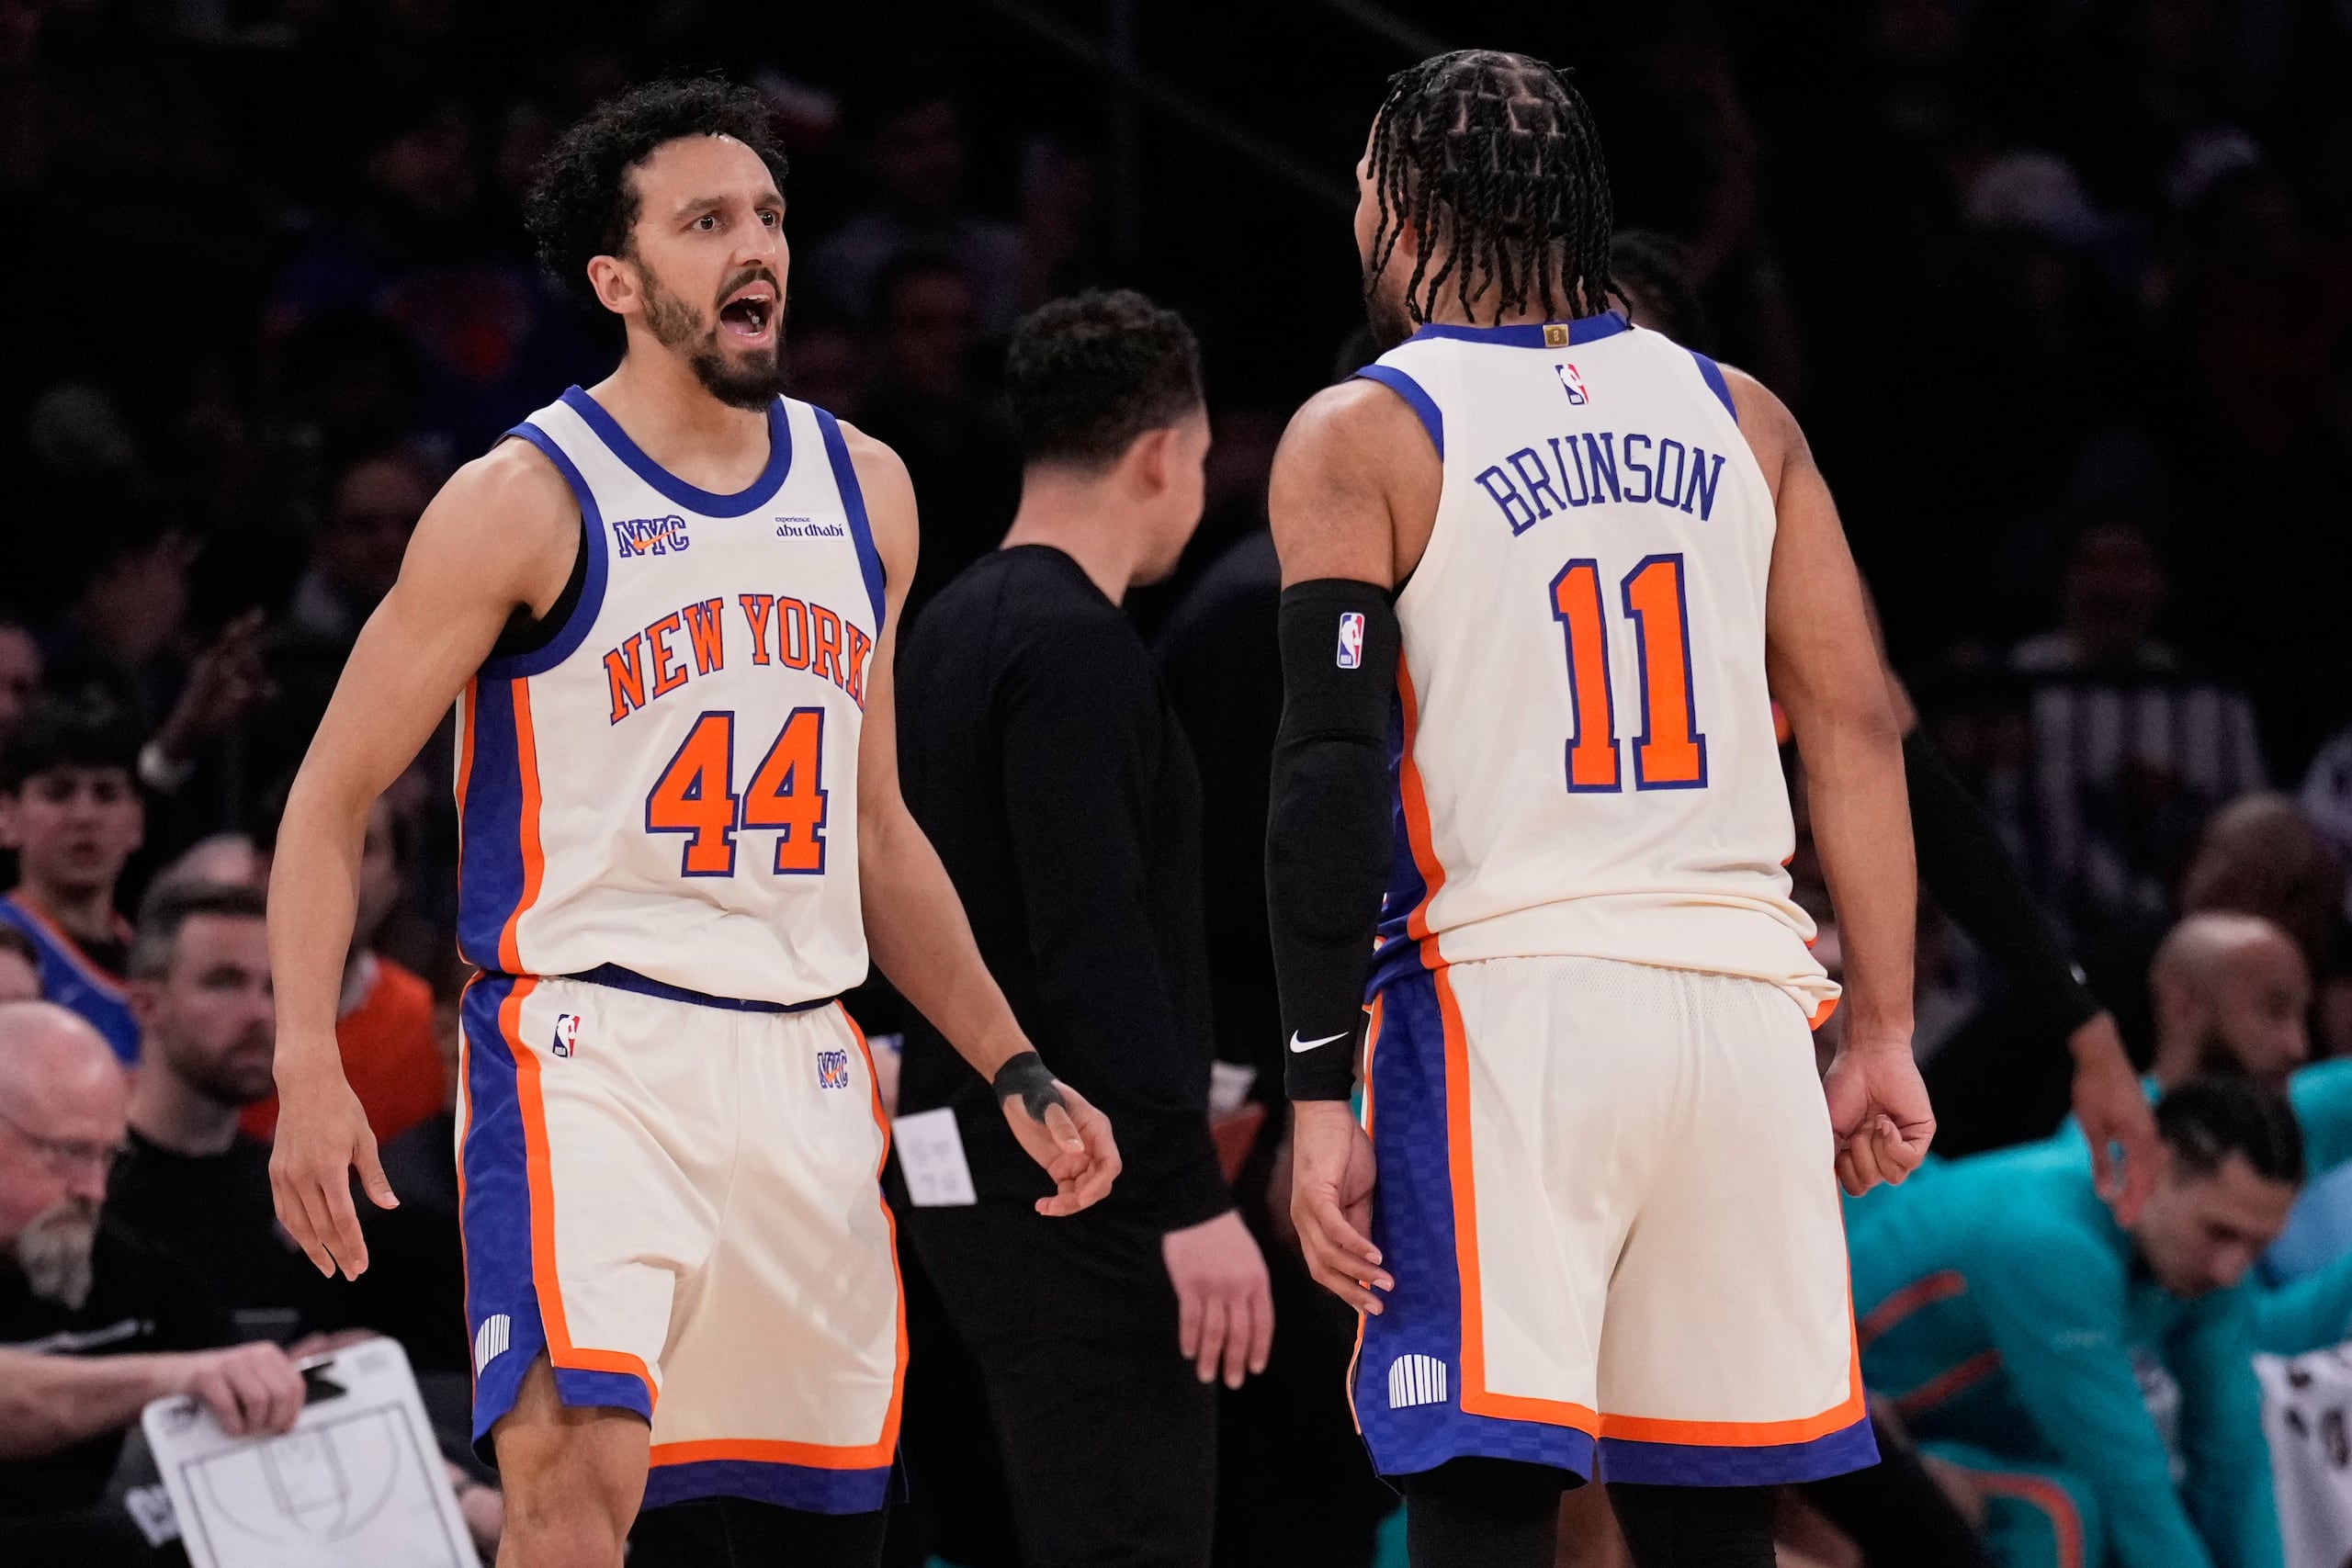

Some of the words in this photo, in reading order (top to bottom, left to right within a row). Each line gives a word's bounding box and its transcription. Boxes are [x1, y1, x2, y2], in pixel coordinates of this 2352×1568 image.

[613, 514, 689, 558] NYC
[776, 524, 802, 536] abu
[805, 524, 843, 536] dhabi
[1474, 433, 1725, 537] BRUNSON
[603, 597, 724, 726] NEW
[739, 593, 872, 713] YORK
[1549, 553, 1708, 793] 11
[646, 706, 829, 877] 44
[818, 1049, 848, 1089] NYC
